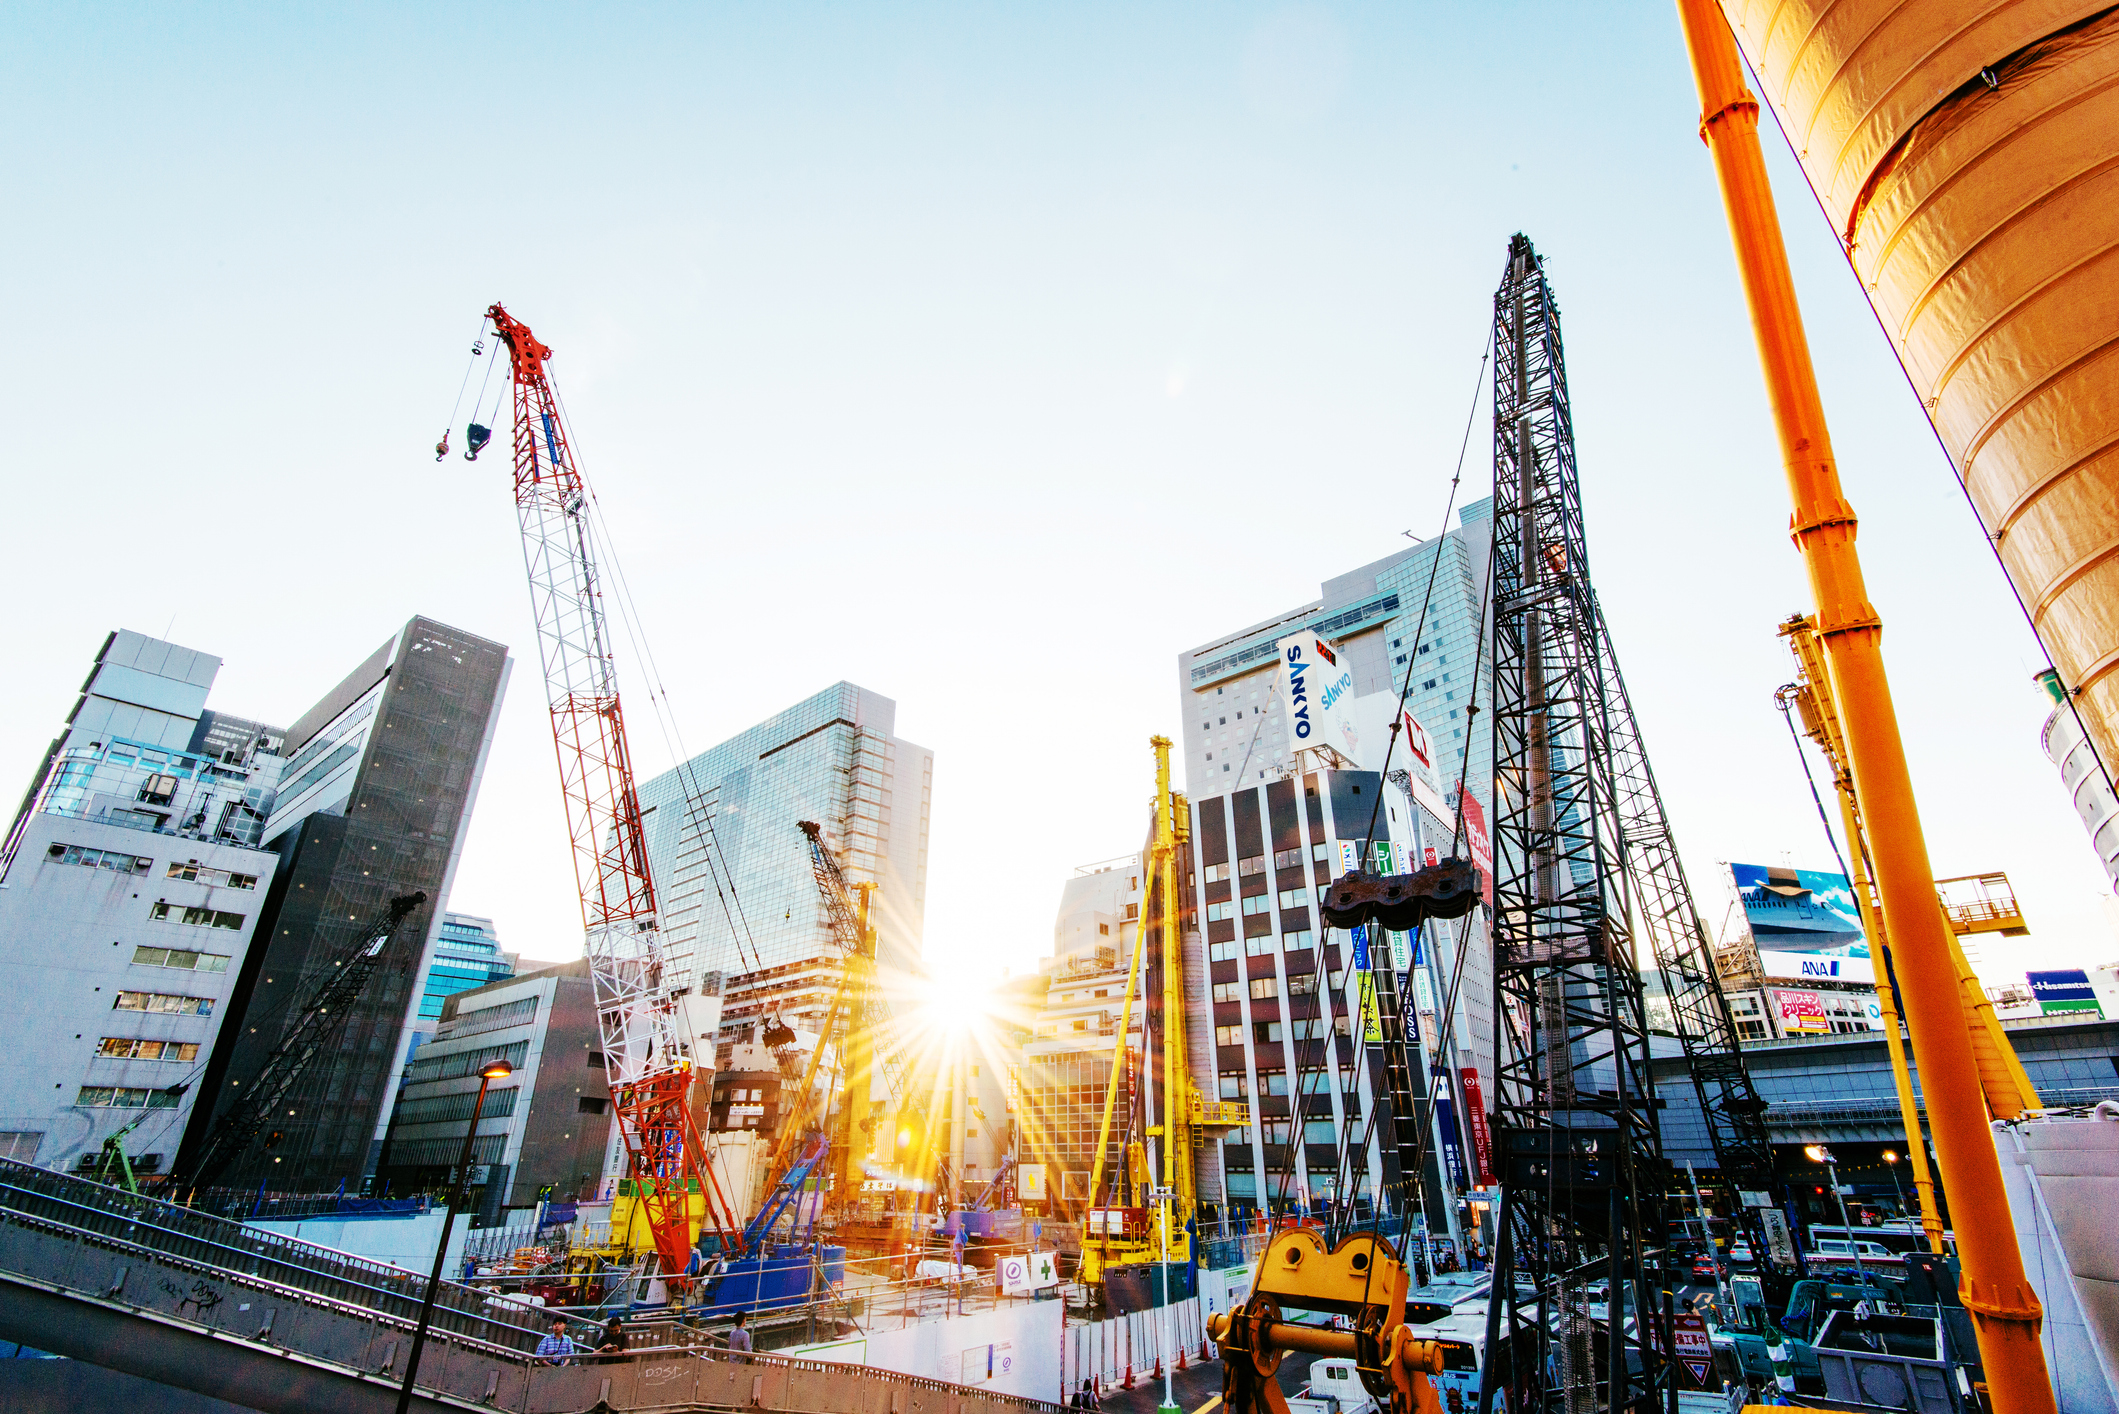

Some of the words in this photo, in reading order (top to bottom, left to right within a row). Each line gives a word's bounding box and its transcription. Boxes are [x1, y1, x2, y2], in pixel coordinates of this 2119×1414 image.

[1801, 961, 1829, 977] ANA
[2033, 981, 2092, 991] Hisamitsu
[1780, 991, 1819, 1005] 品川スキン
[1783, 1003, 1823, 1016] クリニック
